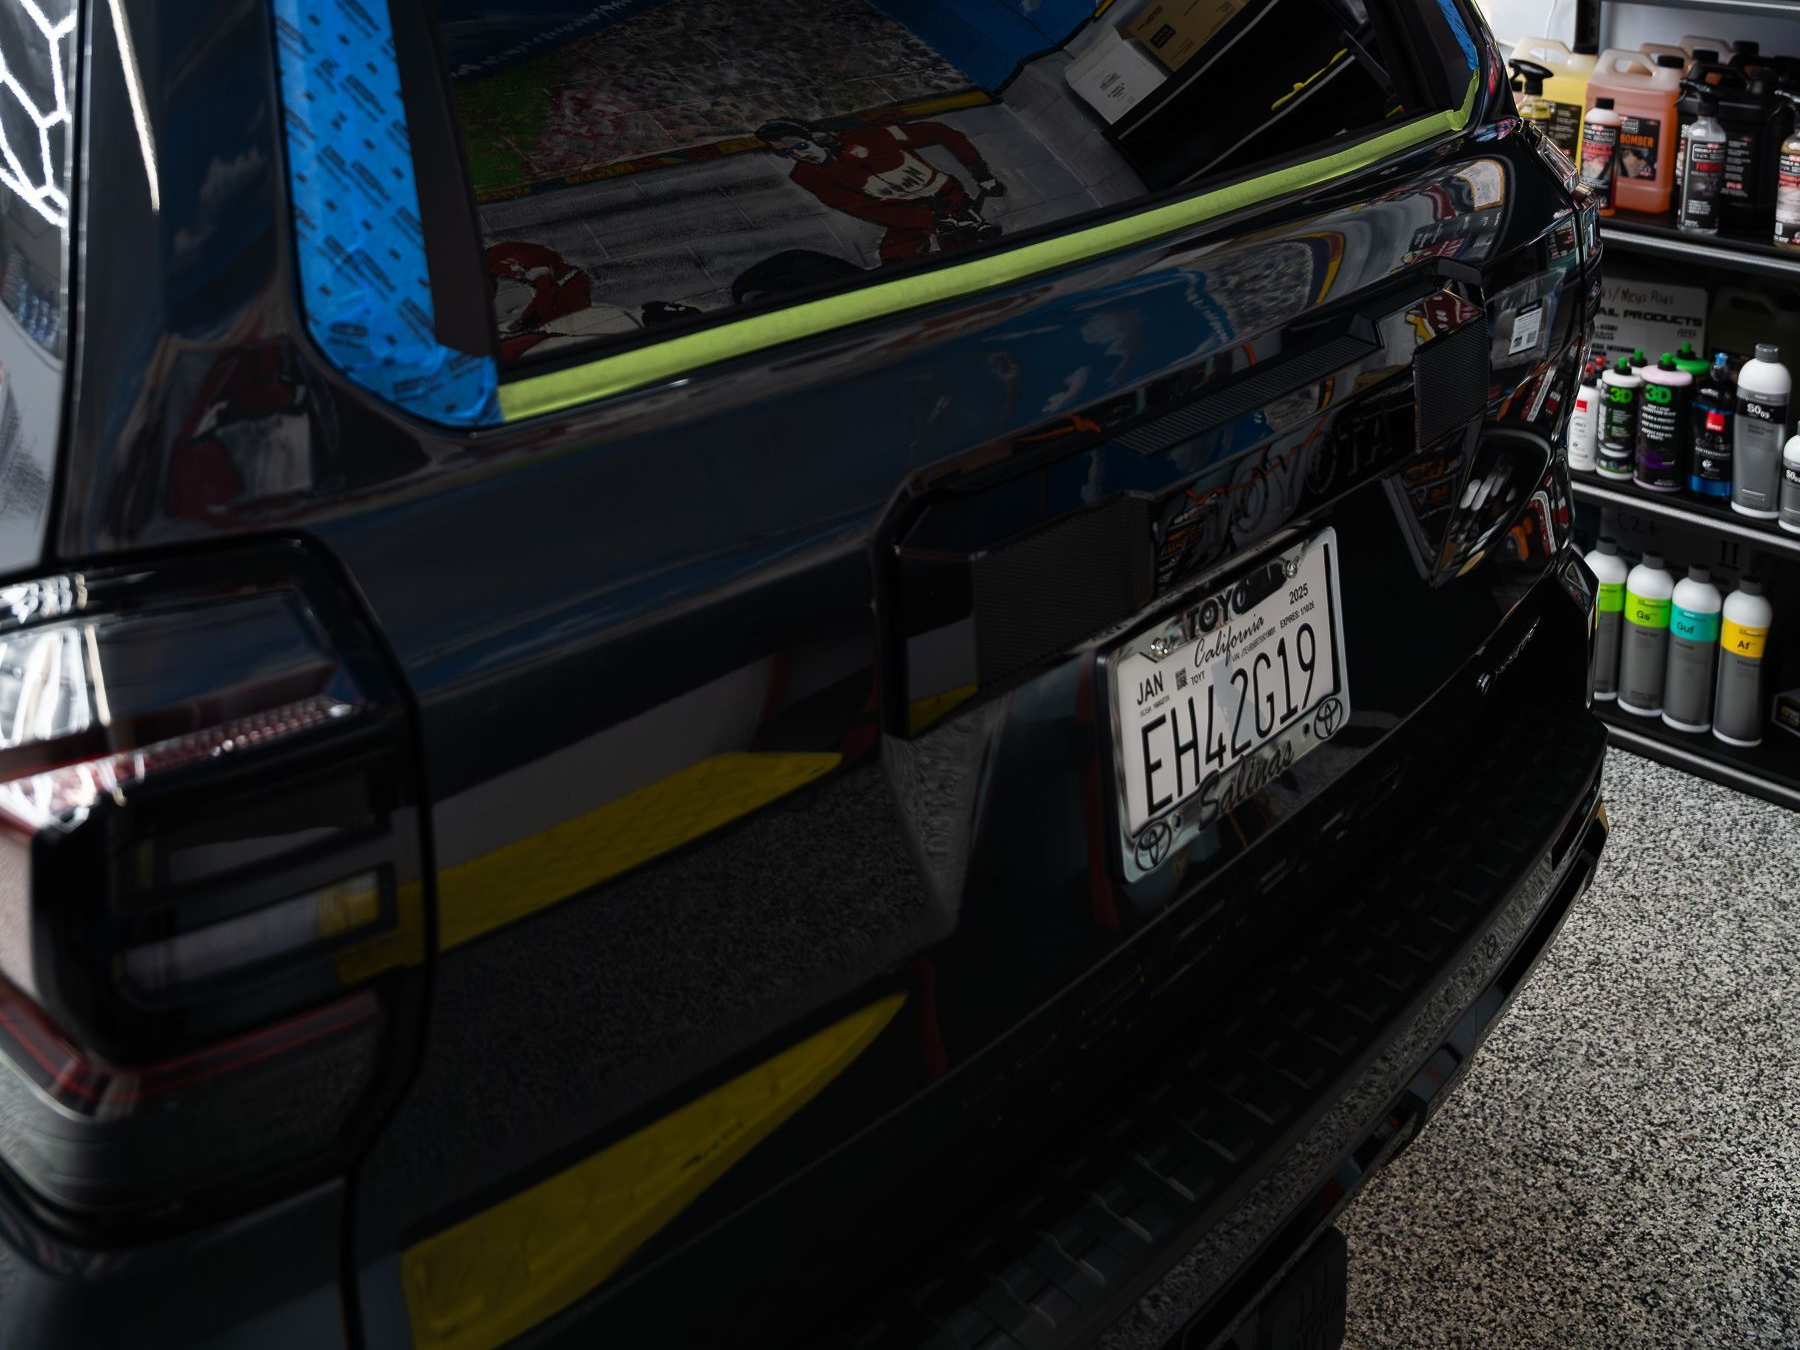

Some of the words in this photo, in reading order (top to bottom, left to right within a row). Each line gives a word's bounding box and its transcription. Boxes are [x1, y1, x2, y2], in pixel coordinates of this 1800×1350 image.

[1619, 133, 1655, 149] BOMBER
[1624, 310, 1703, 327] PRODUCTS
[1608, 386, 1633, 405] 3D
[1644, 383, 1672, 405] 3D
[1288, 582, 1309, 605] 2025
[1279, 611, 1301, 629] EXPIRES:
[1194, 613, 1265, 668] California
[1737, 640, 1751, 651] Af
[1136, 669, 1164, 706] JAN
[1190, 669, 1205, 686] TOYT
[1141, 622, 1317, 816] EH42G19
[1198, 740, 1294, 832] Salinas
